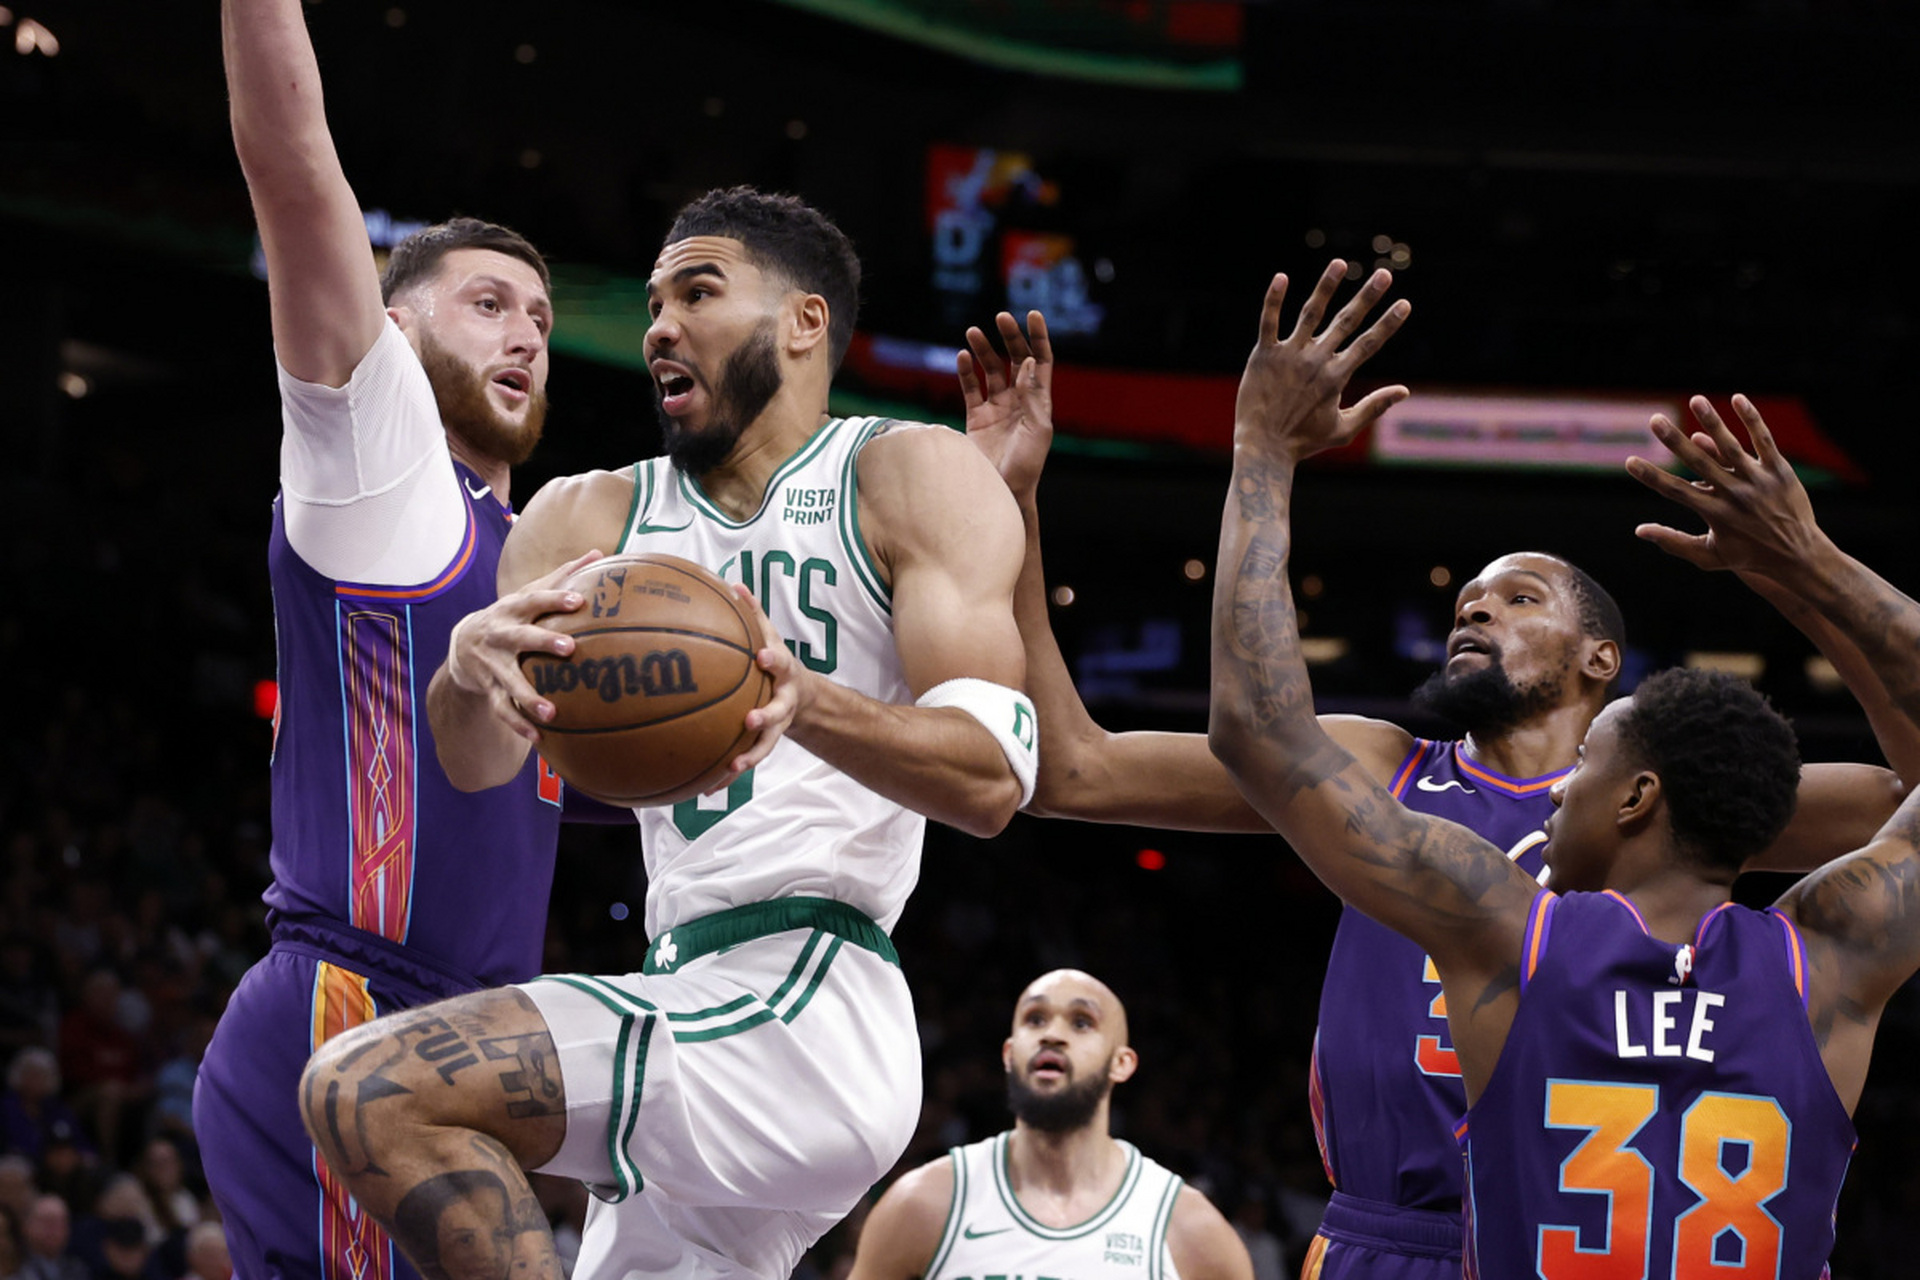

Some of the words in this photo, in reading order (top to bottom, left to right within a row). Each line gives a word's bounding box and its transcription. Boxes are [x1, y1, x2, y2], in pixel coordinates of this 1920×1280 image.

[786, 487, 836, 508] VISTA
[783, 507, 835, 525] PRINT
[532, 648, 698, 703] Wilson
[1614, 990, 1725, 1063] LEE
[1536, 1077, 1792, 1280] 38
[1105, 1233, 1143, 1251] VISTA
[1103, 1250, 1143, 1266] PRINT
